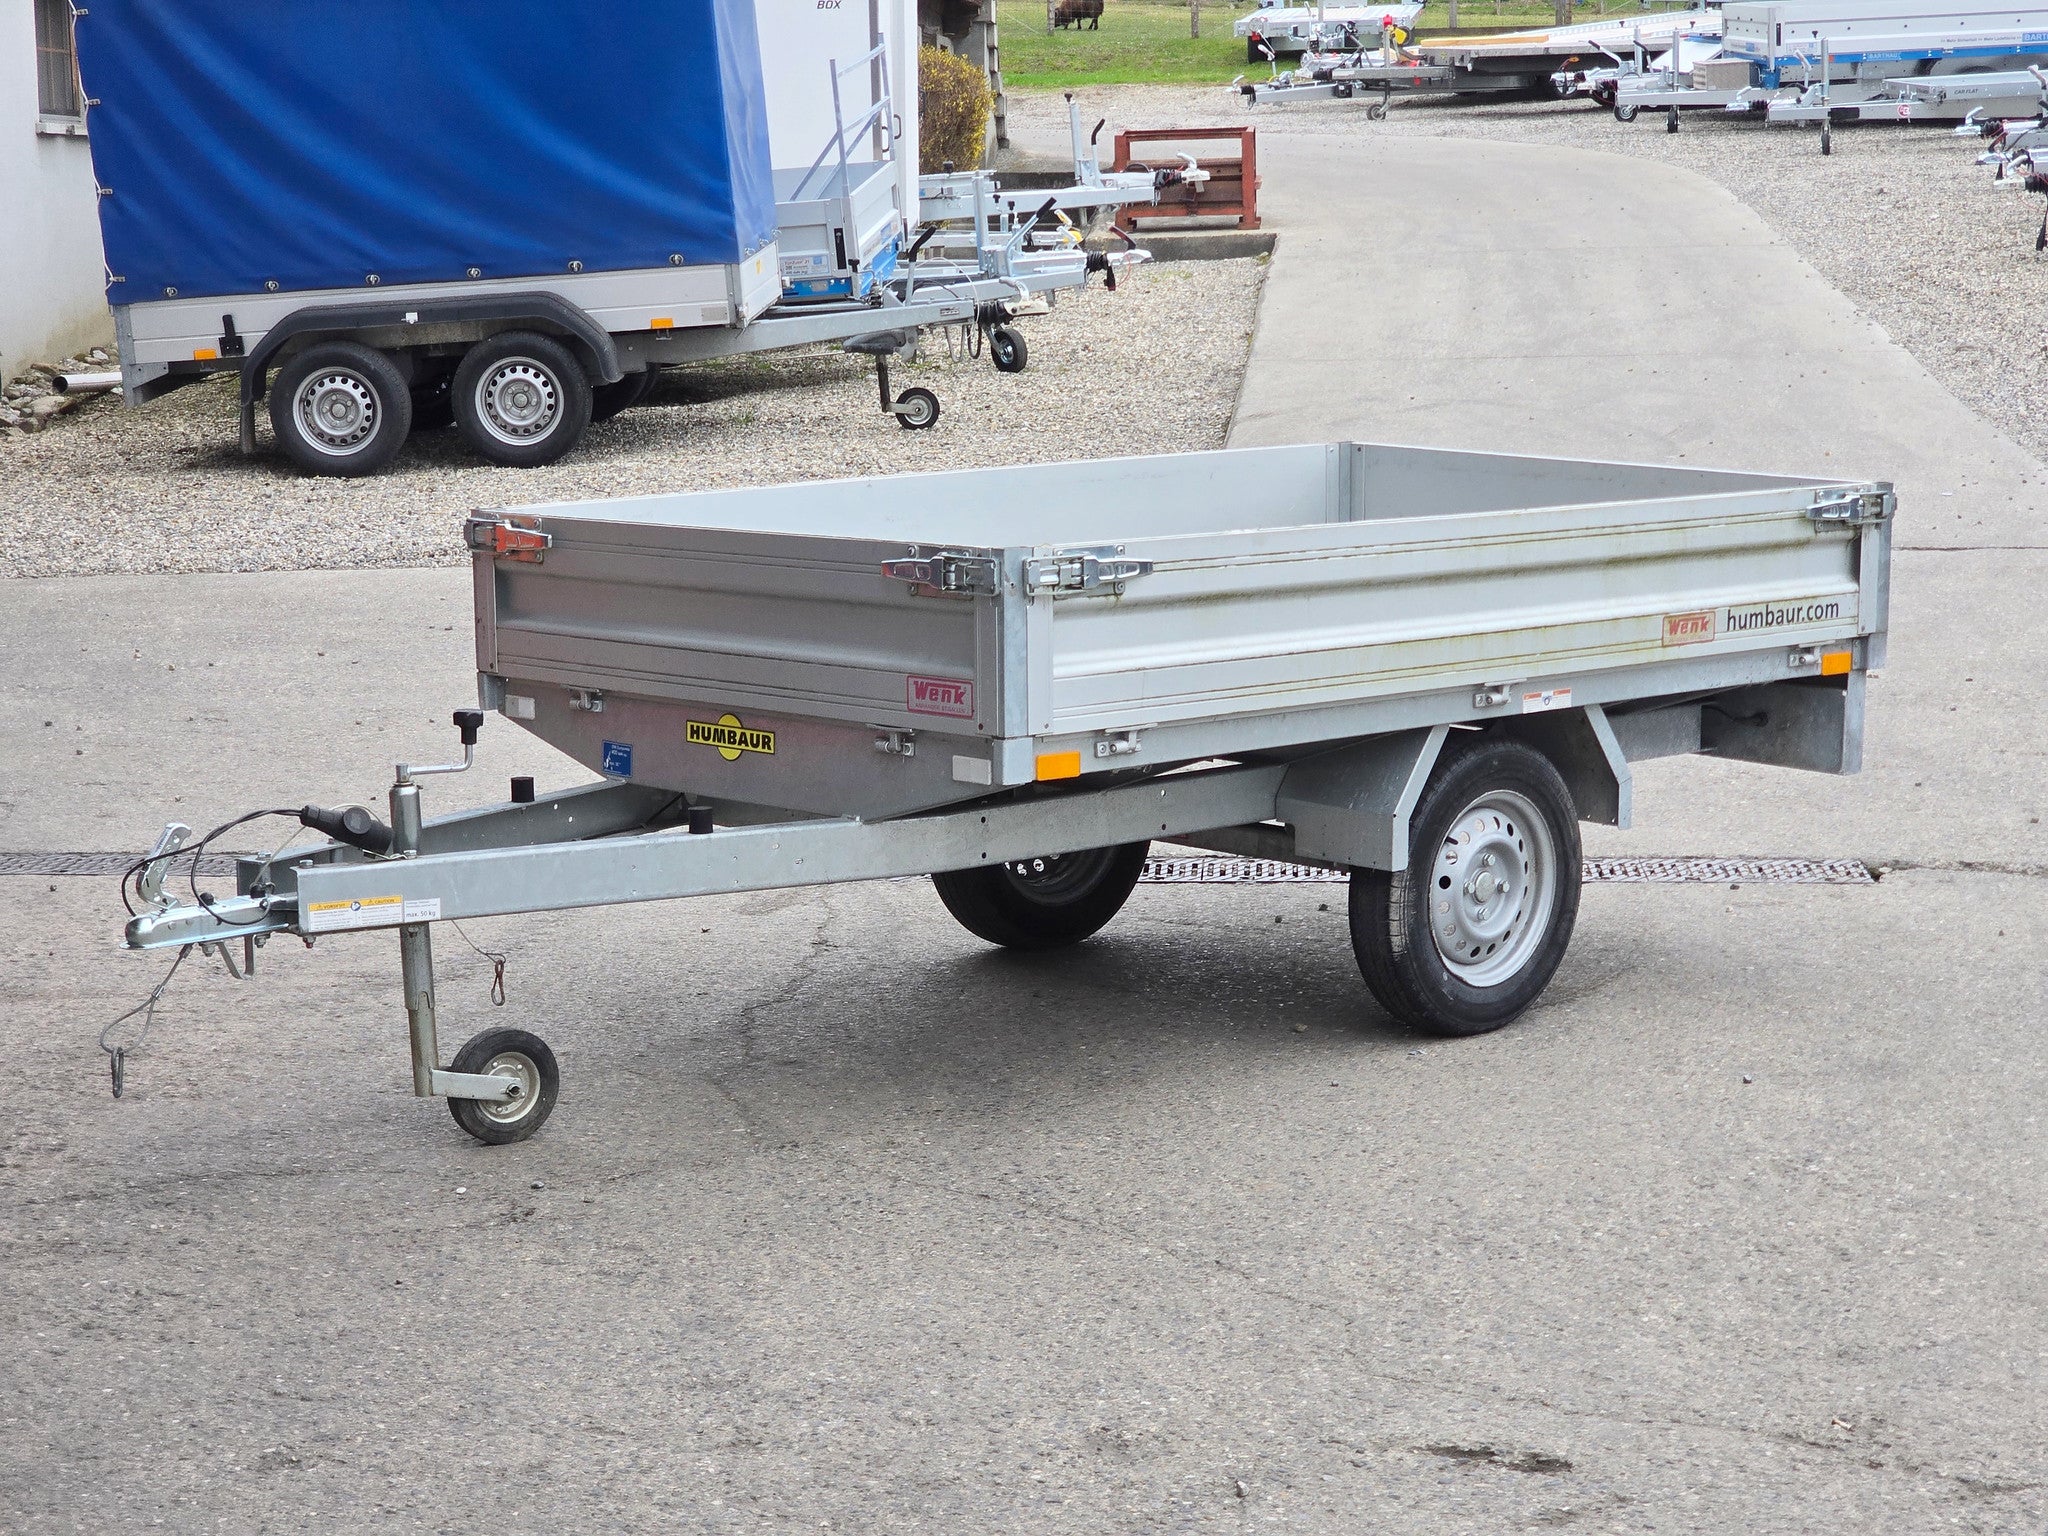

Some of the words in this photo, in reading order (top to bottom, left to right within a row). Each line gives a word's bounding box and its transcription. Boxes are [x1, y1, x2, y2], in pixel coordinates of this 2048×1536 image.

[817, 0, 840, 9] BOX
[1668, 615, 1710, 635] Wenk
[1727, 602, 1839, 631] humbaur.com
[913, 680, 966, 705] Wenk
[689, 724, 772, 751] HUMBAUR
